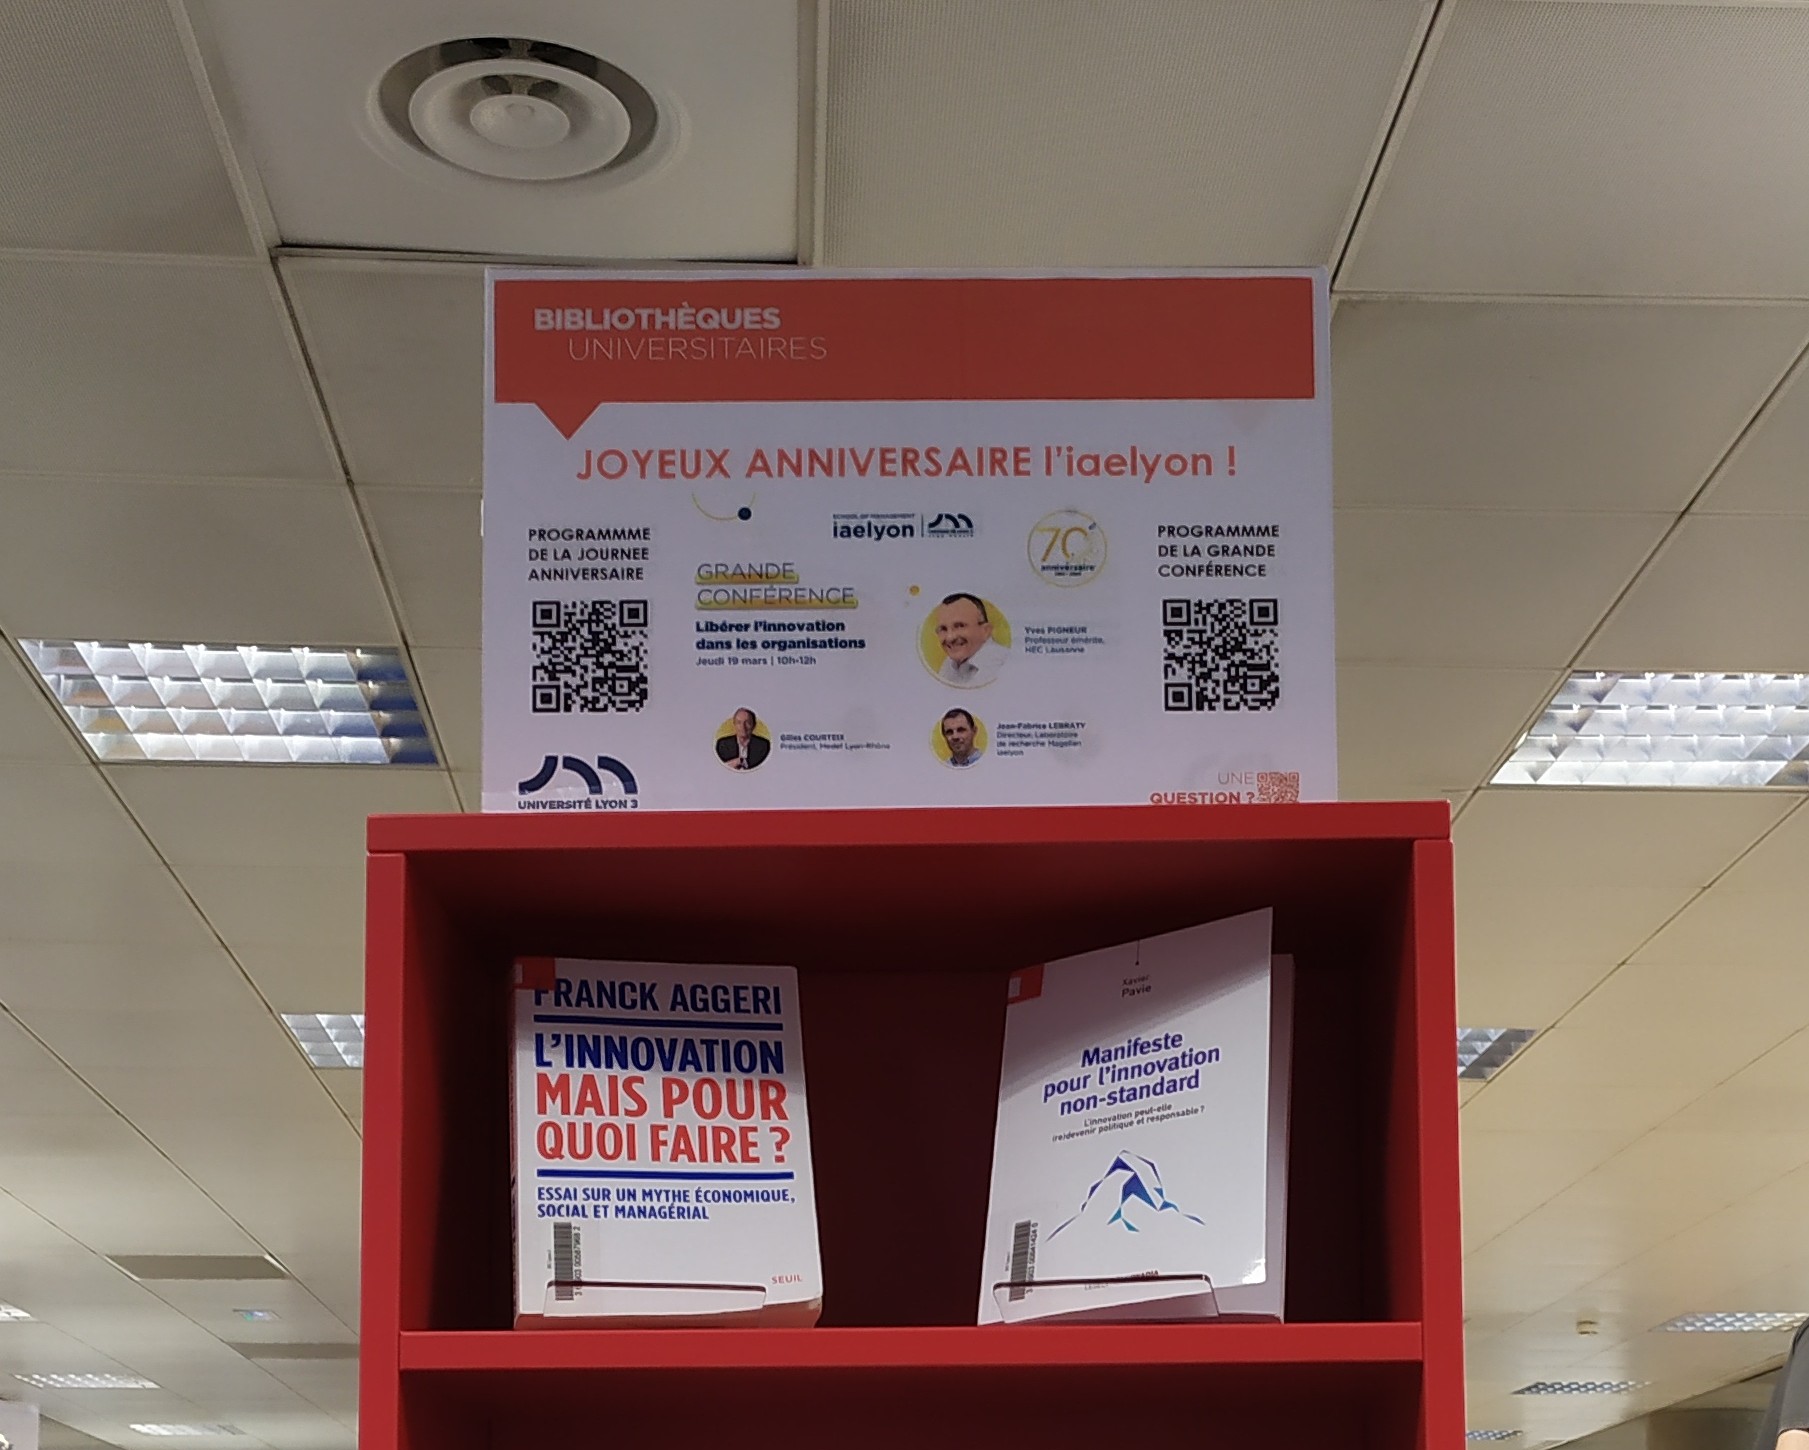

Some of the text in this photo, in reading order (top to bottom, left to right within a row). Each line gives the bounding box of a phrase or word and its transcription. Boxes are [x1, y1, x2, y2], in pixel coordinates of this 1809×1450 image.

[533, 302, 781, 331] BIBLIOTHÈQUES
[568, 336, 828, 360] UNIVERSITAIRES
[576, 445, 1237, 484] JOYEUX ANNIVERSAIRE l'iaelyon !
[528, 527, 651, 541] PROGRAMMME
[832, 521, 915, 541] iaelyon
[1157, 524, 1280, 538] PROGRAMMME
[528, 547, 649, 561] DE LA JOURNEE
[1158, 544, 1276, 557] DE LA GRANDE
[528, 567, 644, 581] ANNIVERSAIRE
[697, 562, 795, 580] GRANDE
[1158, 561, 1267, 577] CONFÉRENCE
[697, 585, 855, 606] CONFÉRENCE
[696, 619, 846, 633] Libérer l'innovation
[1025, 626, 1087, 634] Yves PIGNEUR
[695, 637, 866, 653] dans les organisations
[1025, 636, 1069, 644] Professeur
[695, 655, 817, 666] Jeudi 19 mars 10h-12h
[1217, 771, 1254, 785] UNE
[518, 796, 638, 810] UNIVERSITÉ LYON 3
[1149, 791, 1255, 804] QUESTION ?
[1122, 974, 1150, 986] Xavier
[669, 982, 782, 1015] AGGERI
[1121, 984, 1151, 998] Pavie
[535, 1032, 784, 1074] L'INNOVATION
[1081, 1032, 1183, 1068] Manifeste
[1043, 1047, 1220, 1103] pour l'innovation
[537, 1073, 789, 1121] MAIS POUR
[1060, 1069, 1200, 1116] non-standard
[1084, 1103, 1173, 1127] L'innovation peut-elle
[1052, 1107, 1199, 1142] (re)devenir politique et responsable
[537, 1120, 791, 1164] QUOI FAIRE ?
[537, 1186, 796, 1204] ESSAI SUR UN MYTHE ÉCONOMIQUE,
[537, 1202, 710, 1220] SOCIAL ET MANAGÉRIAL
[771, 1274, 803, 1284] SEUIL
